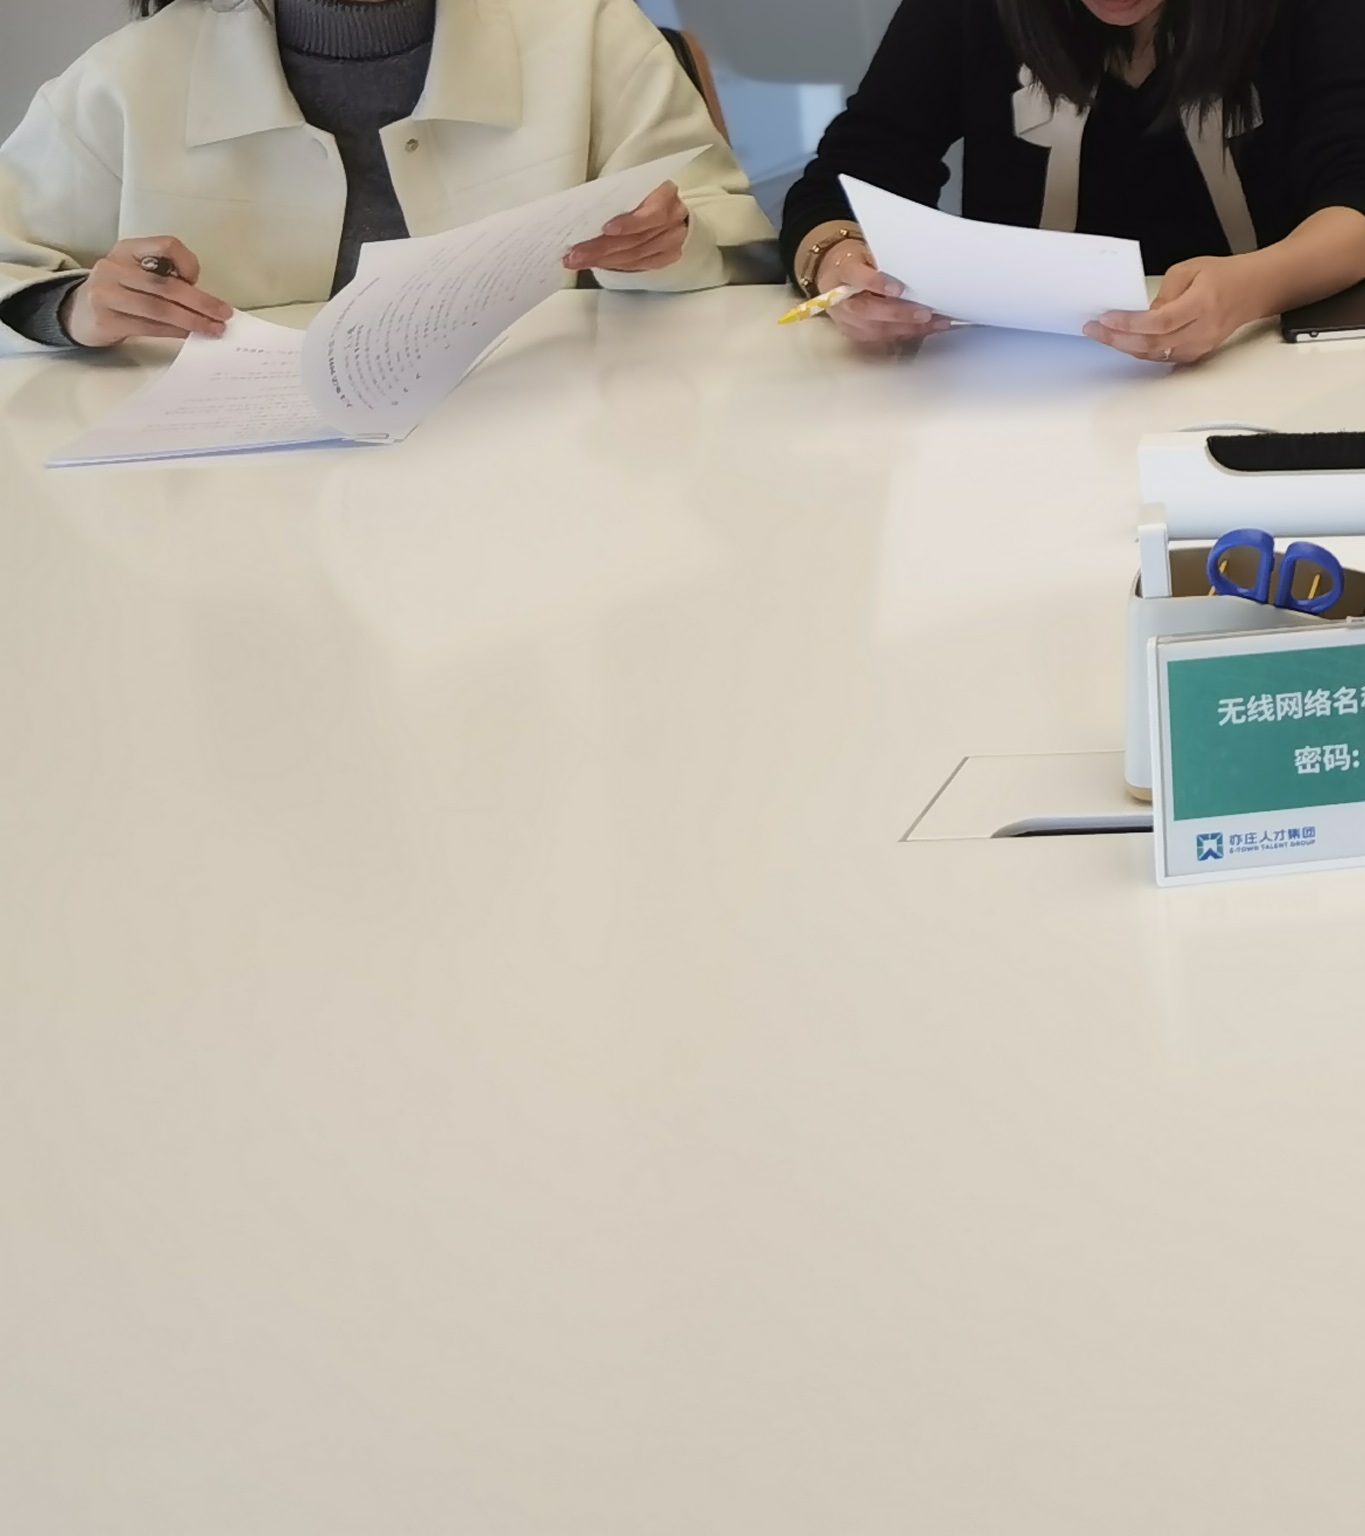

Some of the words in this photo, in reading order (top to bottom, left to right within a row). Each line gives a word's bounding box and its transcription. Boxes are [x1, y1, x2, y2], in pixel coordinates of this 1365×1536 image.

[1294, 743, 1360, 774] 密码:
[1229, 826, 1316, 846] 亦庄人才集团
